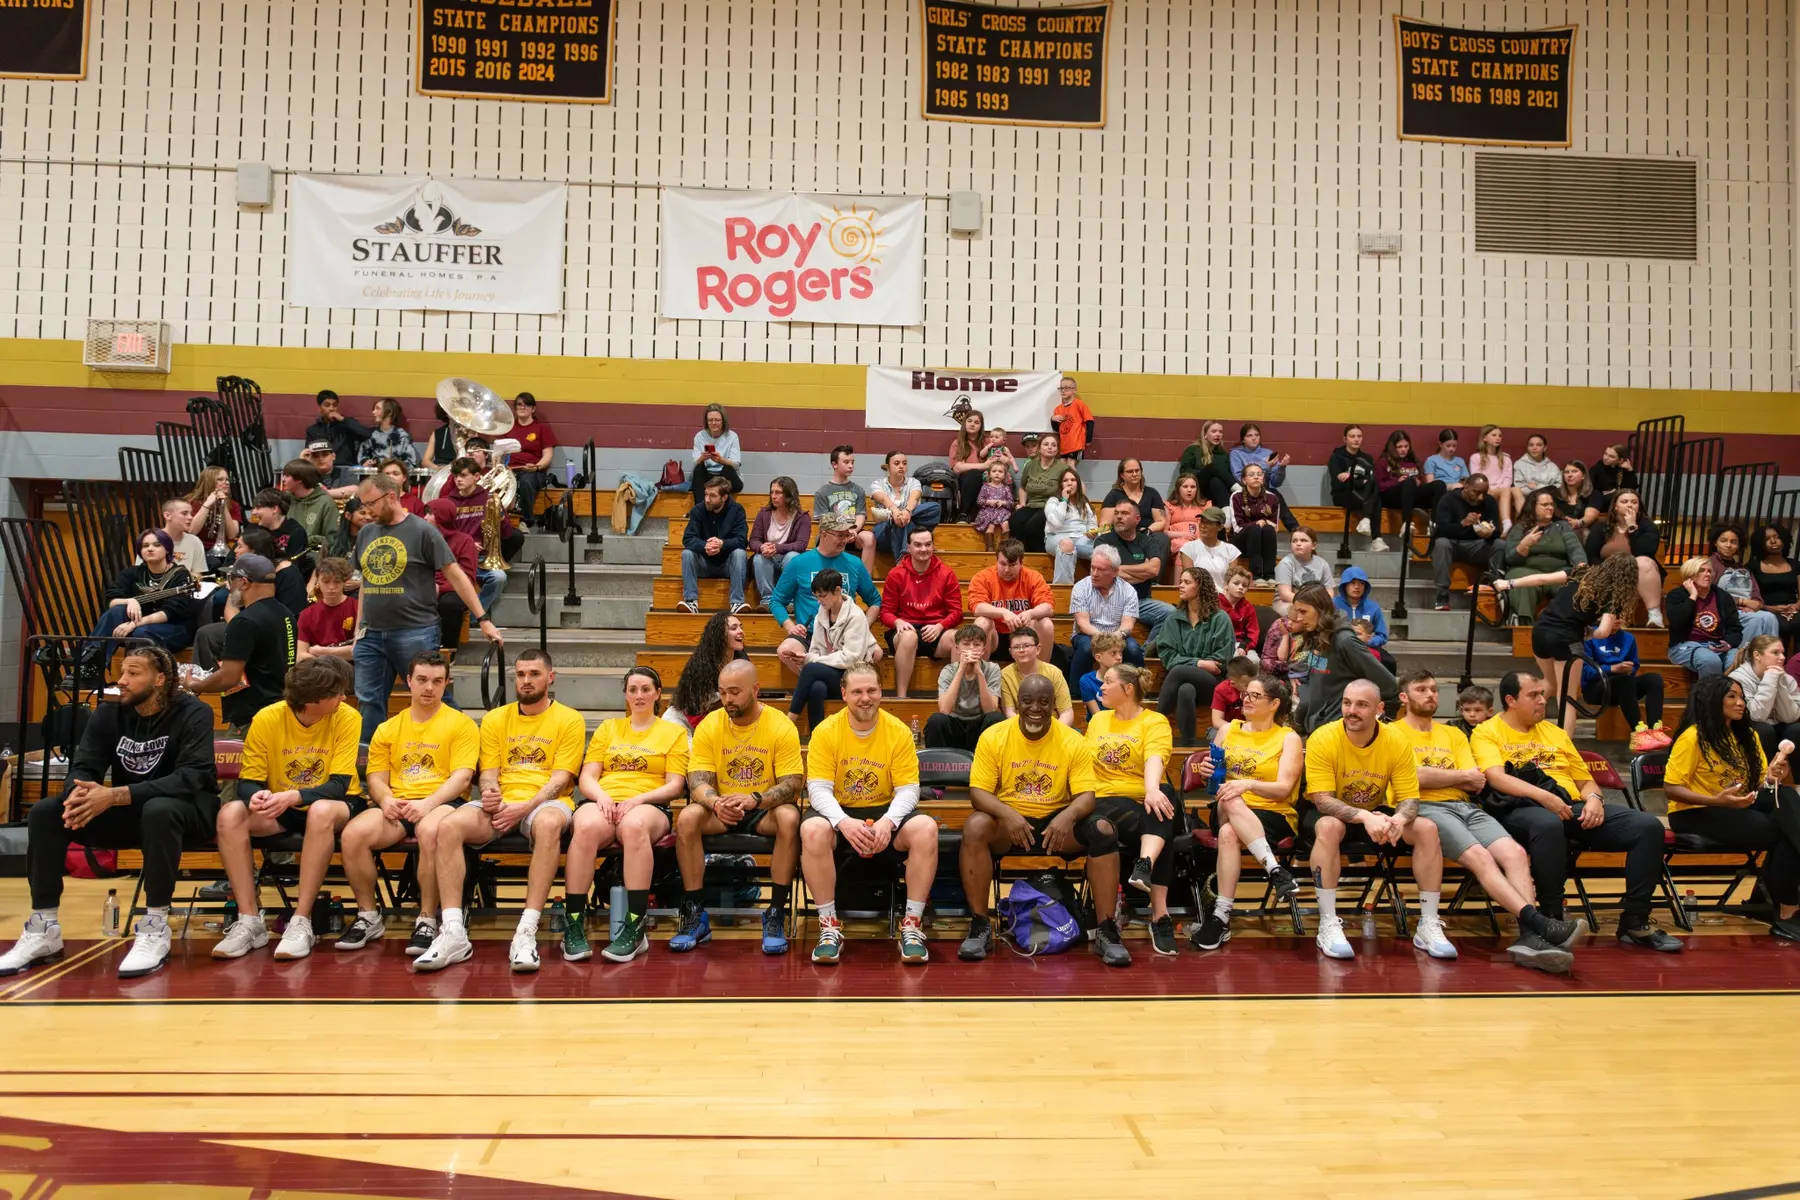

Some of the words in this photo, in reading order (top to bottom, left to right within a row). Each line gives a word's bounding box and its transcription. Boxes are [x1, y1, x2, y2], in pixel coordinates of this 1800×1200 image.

[433, 8, 487, 30] STATE
[500, 13, 599, 35] CHAMPIONS
[927, 7, 972, 28] GIRLS'
[981, 14, 1026, 32] CROSS
[1037, 16, 1103, 33] COUNTRY
[431, 34, 467, 55] 1990
[475, 38, 508, 58] 1991
[520, 41, 556, 60] 1992
[564, 42, 599, 61] 1996
[936, 34, 987, 56] STATE
[1000, 39, 1093, 60] CHAMPIONS
[1402, 30, 1444, 50] BOYS'
[1450, 36, 1496, 54] CROSS
[1501, 38, 1570, 56] COUNTRY
[429, 57, 466, 77] 2015
[475, 61, 511, 80] 2016
[518, 63, 556, 82] 2024
[935, 61, 969, 81] 1982
[976, 64, 1010, 84] 1983
[1018, 67, 1049, 86] 1991
[1059, 68, 1092, 87] 1992
[1412, 57, 1459, 77] STATE
[1471, 62, 1560, 81] CHAMPIONS
[935, 88, 968, 108] 1985
[976, 92, 1009, 111] 1993
[1412, 83, 1443, 101] 1965
[1450, 85, 1482, 104] 1966
[1489, 88, 1521, 106] 1989
[1527, 90, 1558, 108] 2021
[352, 238, 504, 266] STAUFFER
[724, 216, 822, 268] Roy
[354, 270, 414, 278] FUNERAL
[362, 284, 424, 300] Celebrating
[425, 287, 452, 300] Life's
[452, 289, 496, 303] Journey
[696, 265, 874, 318] Rogers
[117, 333, 143, 353] EXIT
[911, 370, 1018, 393] Home
[284, 616, 296, 666] Hamilton
[303, 769, 312, 782] 2
[739, 767, 753, 780] 10
[855, 779, 864, 793] 5
[1026, 782, 1042, 796] 34
[1353, 791, 1370, 803] 22
